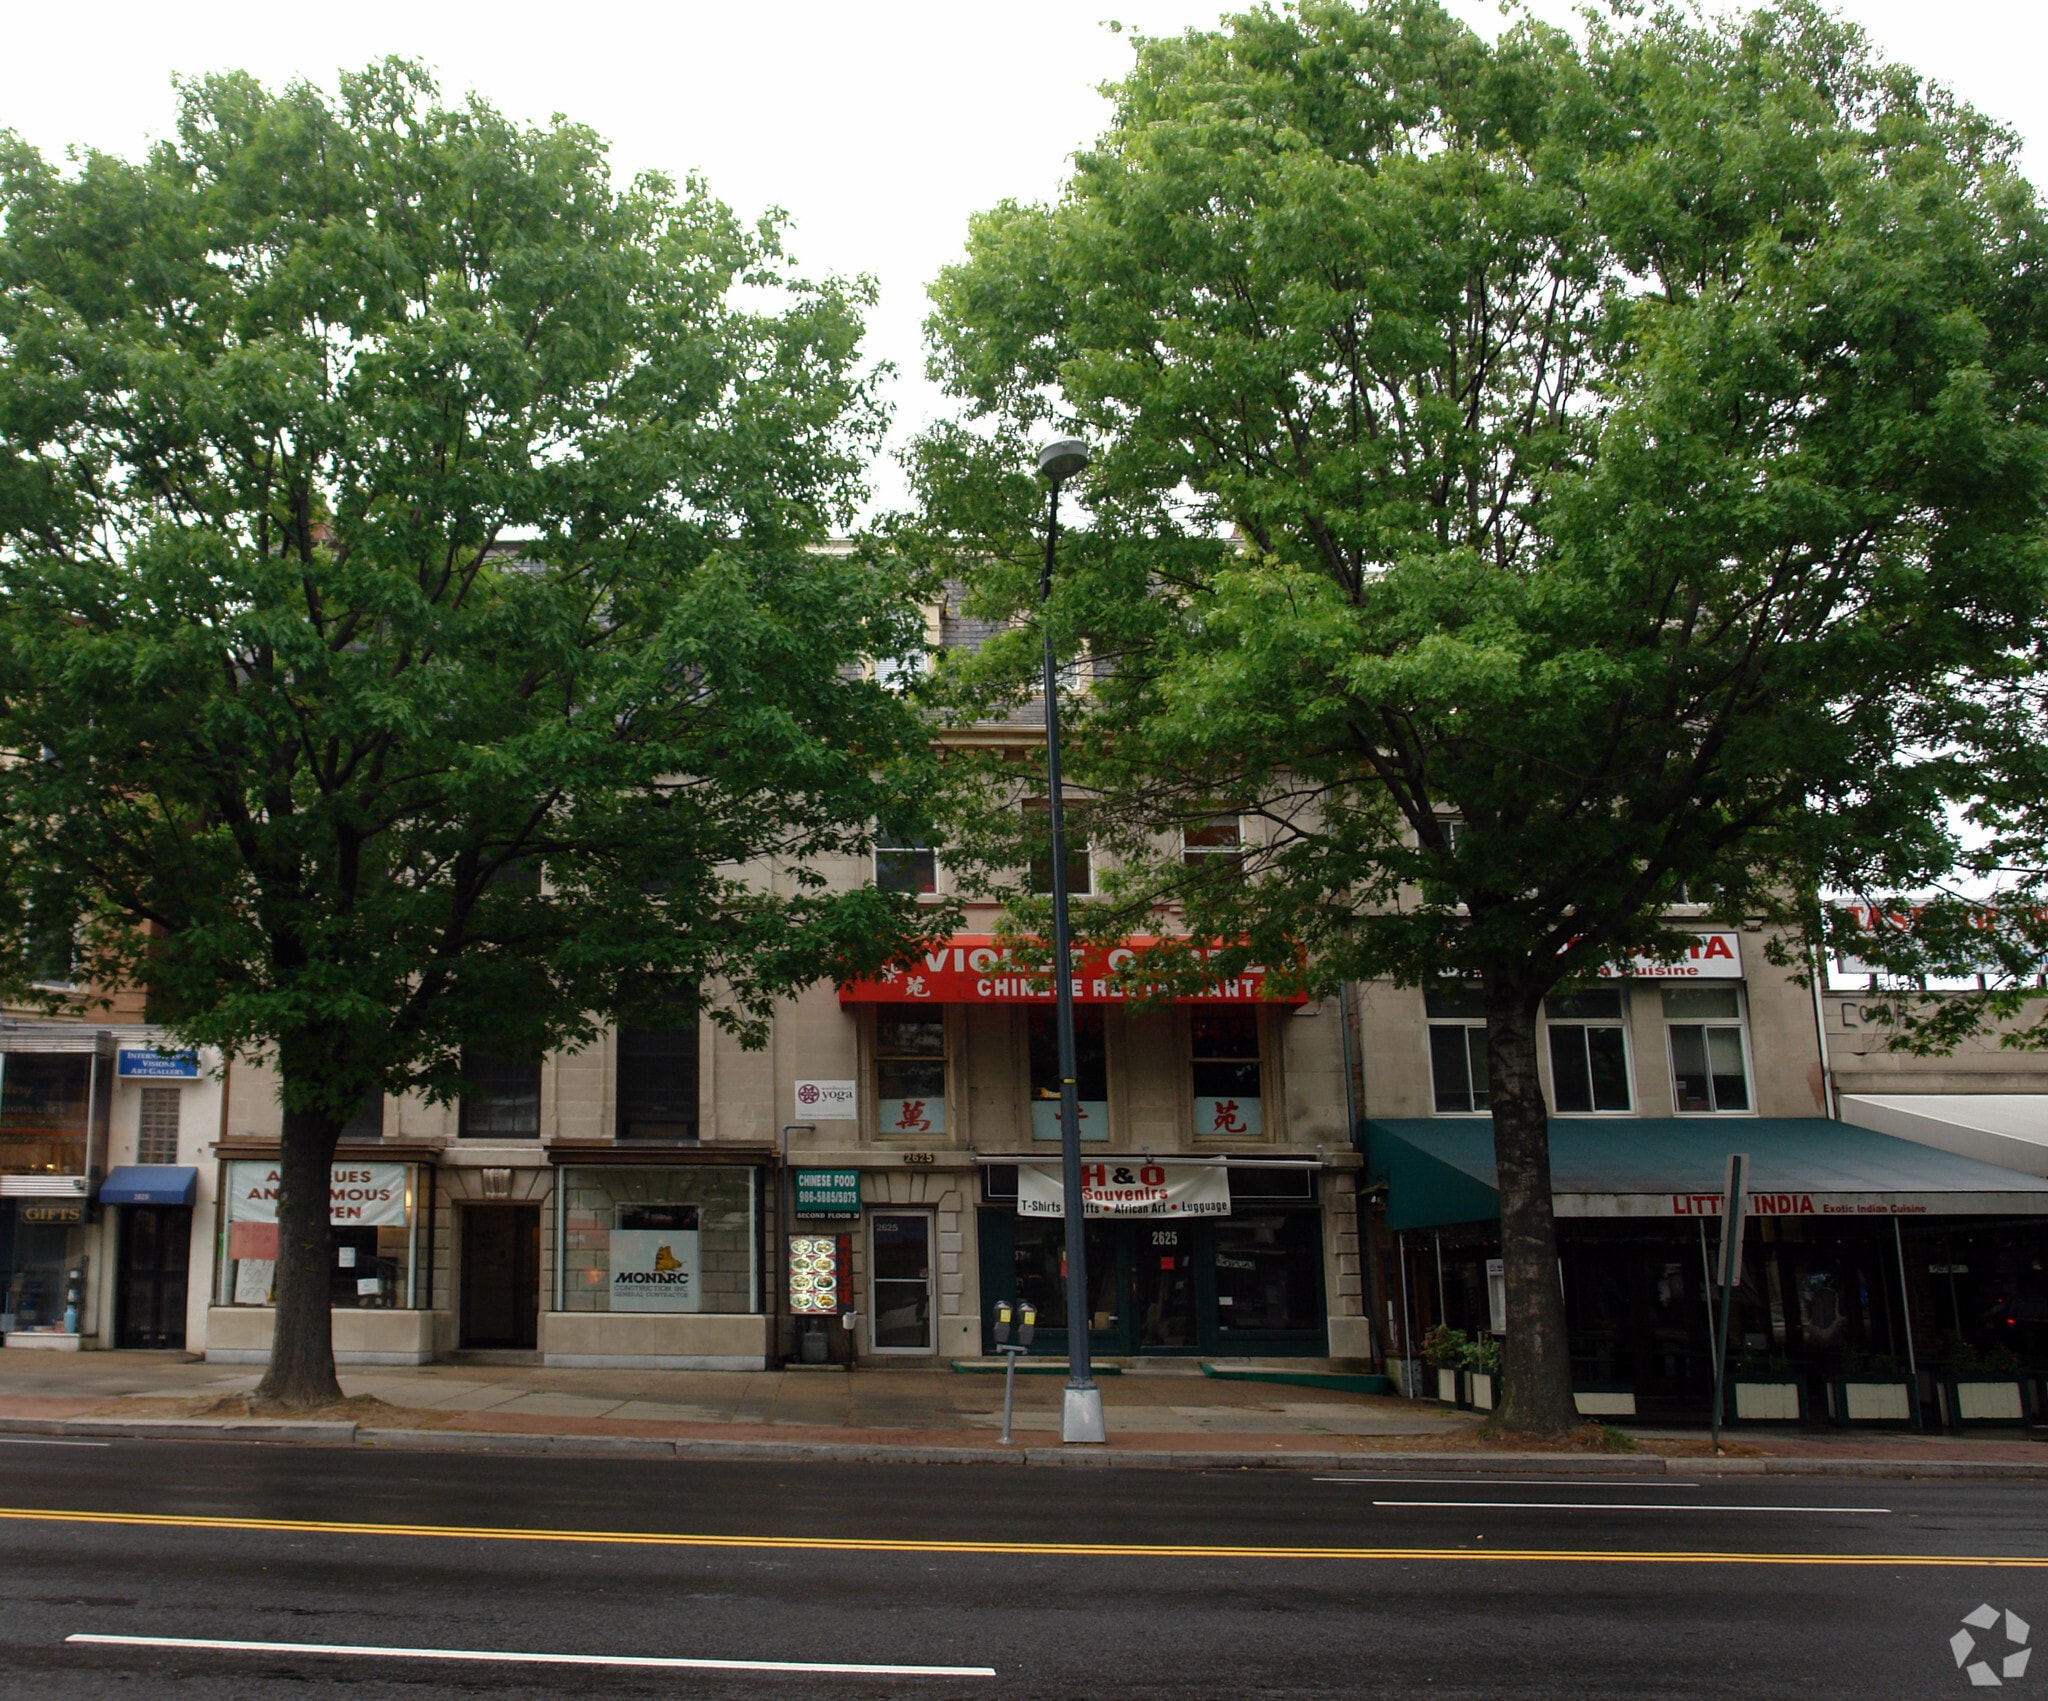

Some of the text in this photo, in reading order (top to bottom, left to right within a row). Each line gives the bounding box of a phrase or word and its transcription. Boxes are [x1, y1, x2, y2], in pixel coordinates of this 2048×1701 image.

[977, 978, 1254, 998] CHINE RETAANT
[821, 1091, 853, 1102] yoga
[905, 1153, 933, 1163] 2625
[798, 1174, 856, 1187] CHINESE FOOD
[246, 1188, 391, 1201] ANMOUS
[1081, 1187, 1168, 1201] Souvenirs
[1021, 1200, 1061, 1213] T-Shirts
[1114, 1203, 1149, 1214] African
[1151, 1202, 1166, 1213] Art
[1182, 1201, 1227, 1213] Lugguage
[1672, 1195, 1927, 1215] LITT INDIA Exotic Indian Cuisine
[25, 1207, 80, 1220] GIFTS
[876, 1223, 899, 1232] 2625
[1152, 1231, 1178, 1245] 2625
[614, 1271, 689, 1284] MONARC
